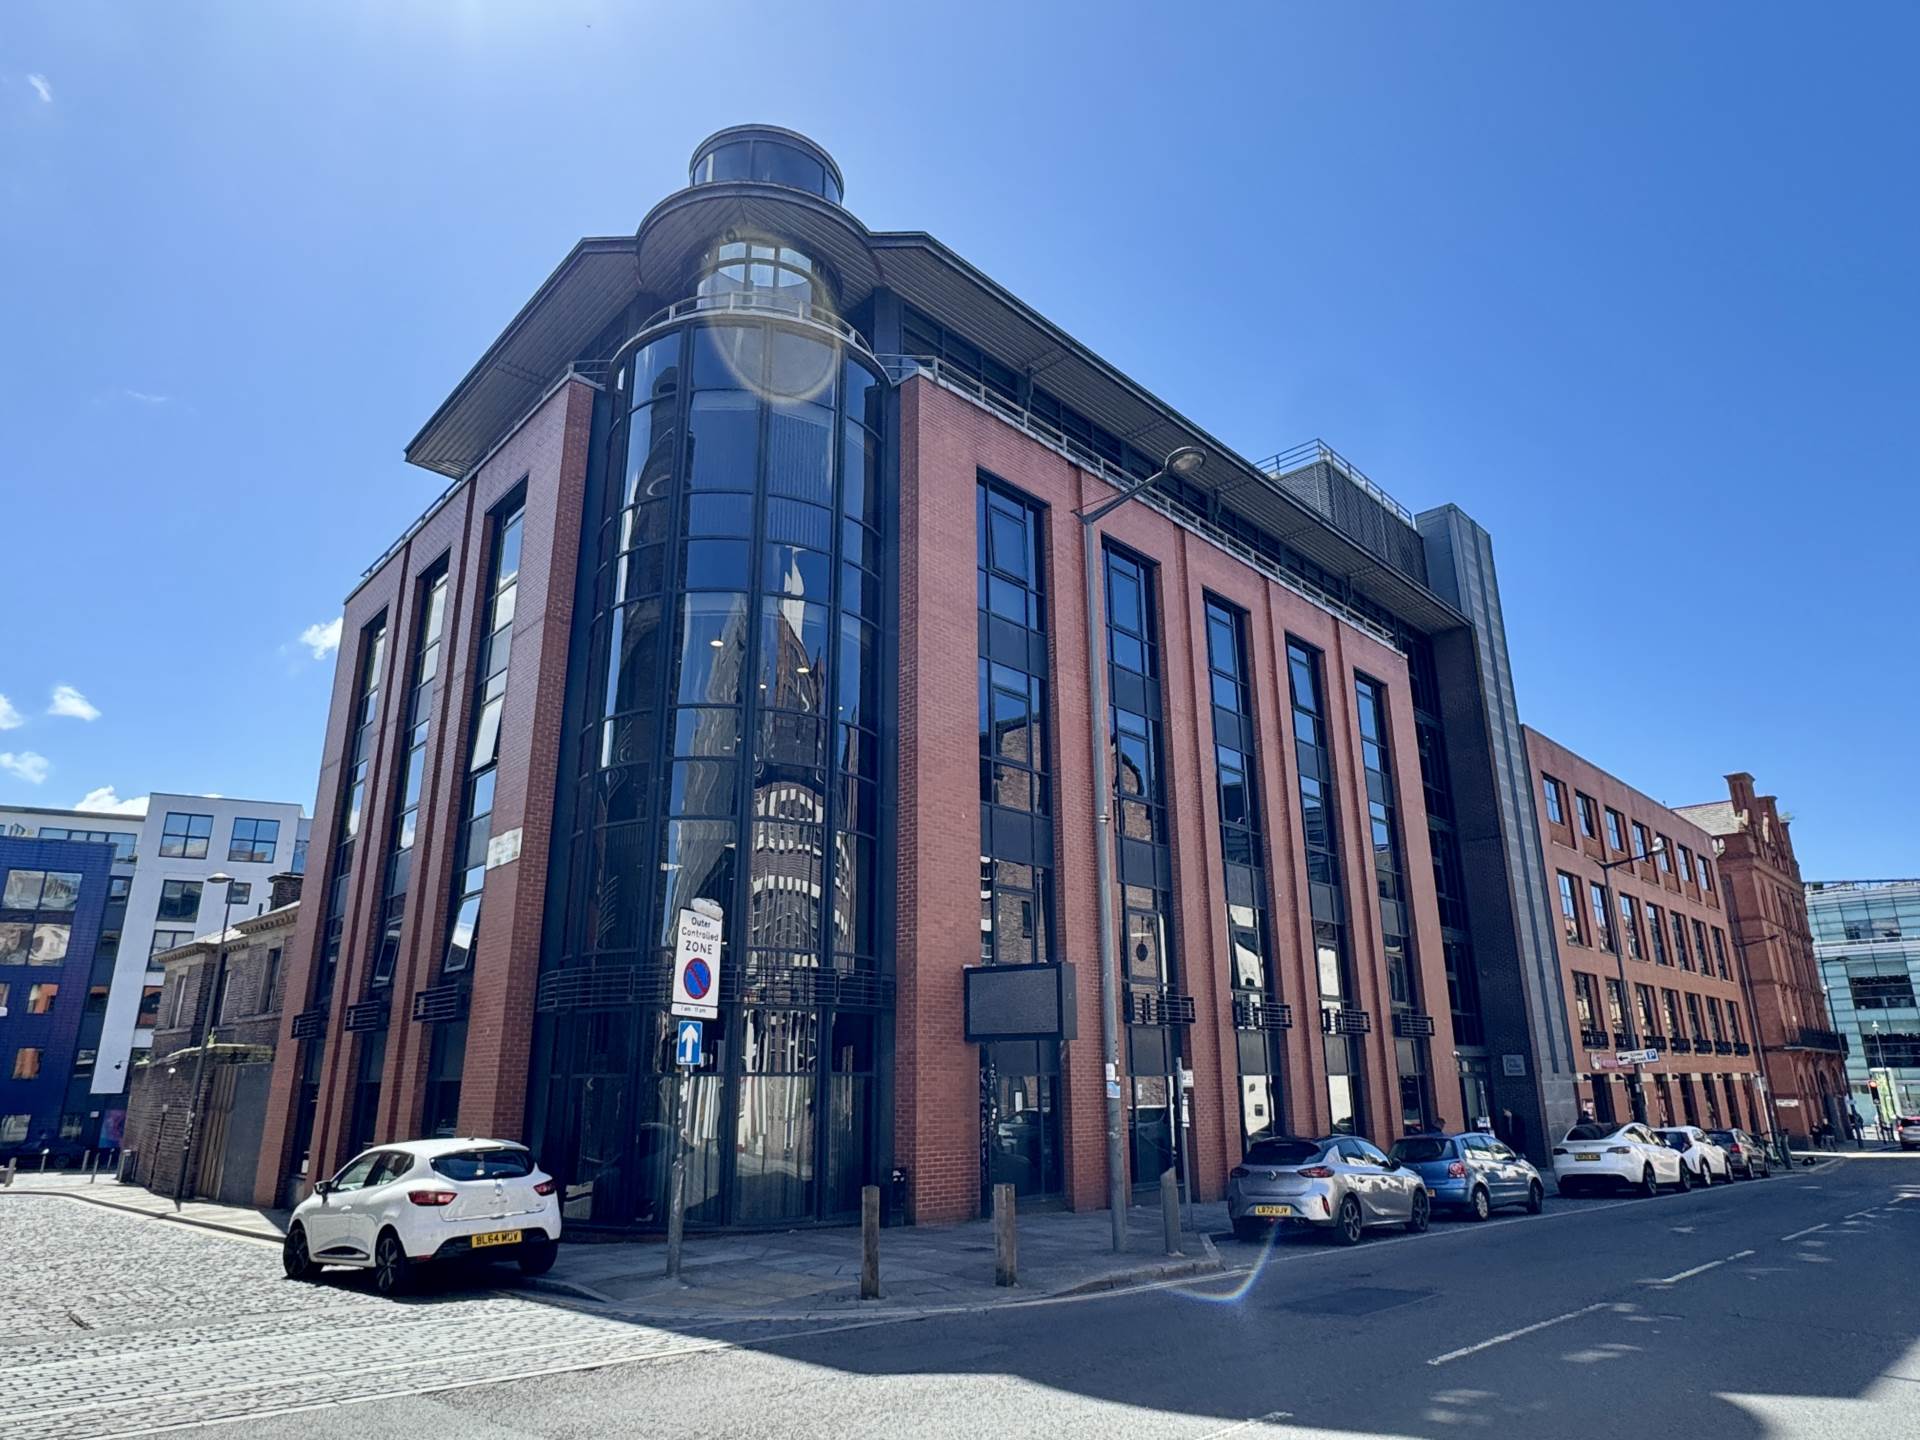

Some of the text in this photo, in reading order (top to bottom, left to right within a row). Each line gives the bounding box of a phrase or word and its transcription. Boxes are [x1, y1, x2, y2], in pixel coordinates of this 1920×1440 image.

[691, 916, 711, 928] Outer
[681, 926, 719, 941] Controlled
[685, 940, 712, 955] ZONE
[476, 1233, 499, 1246] BL64
